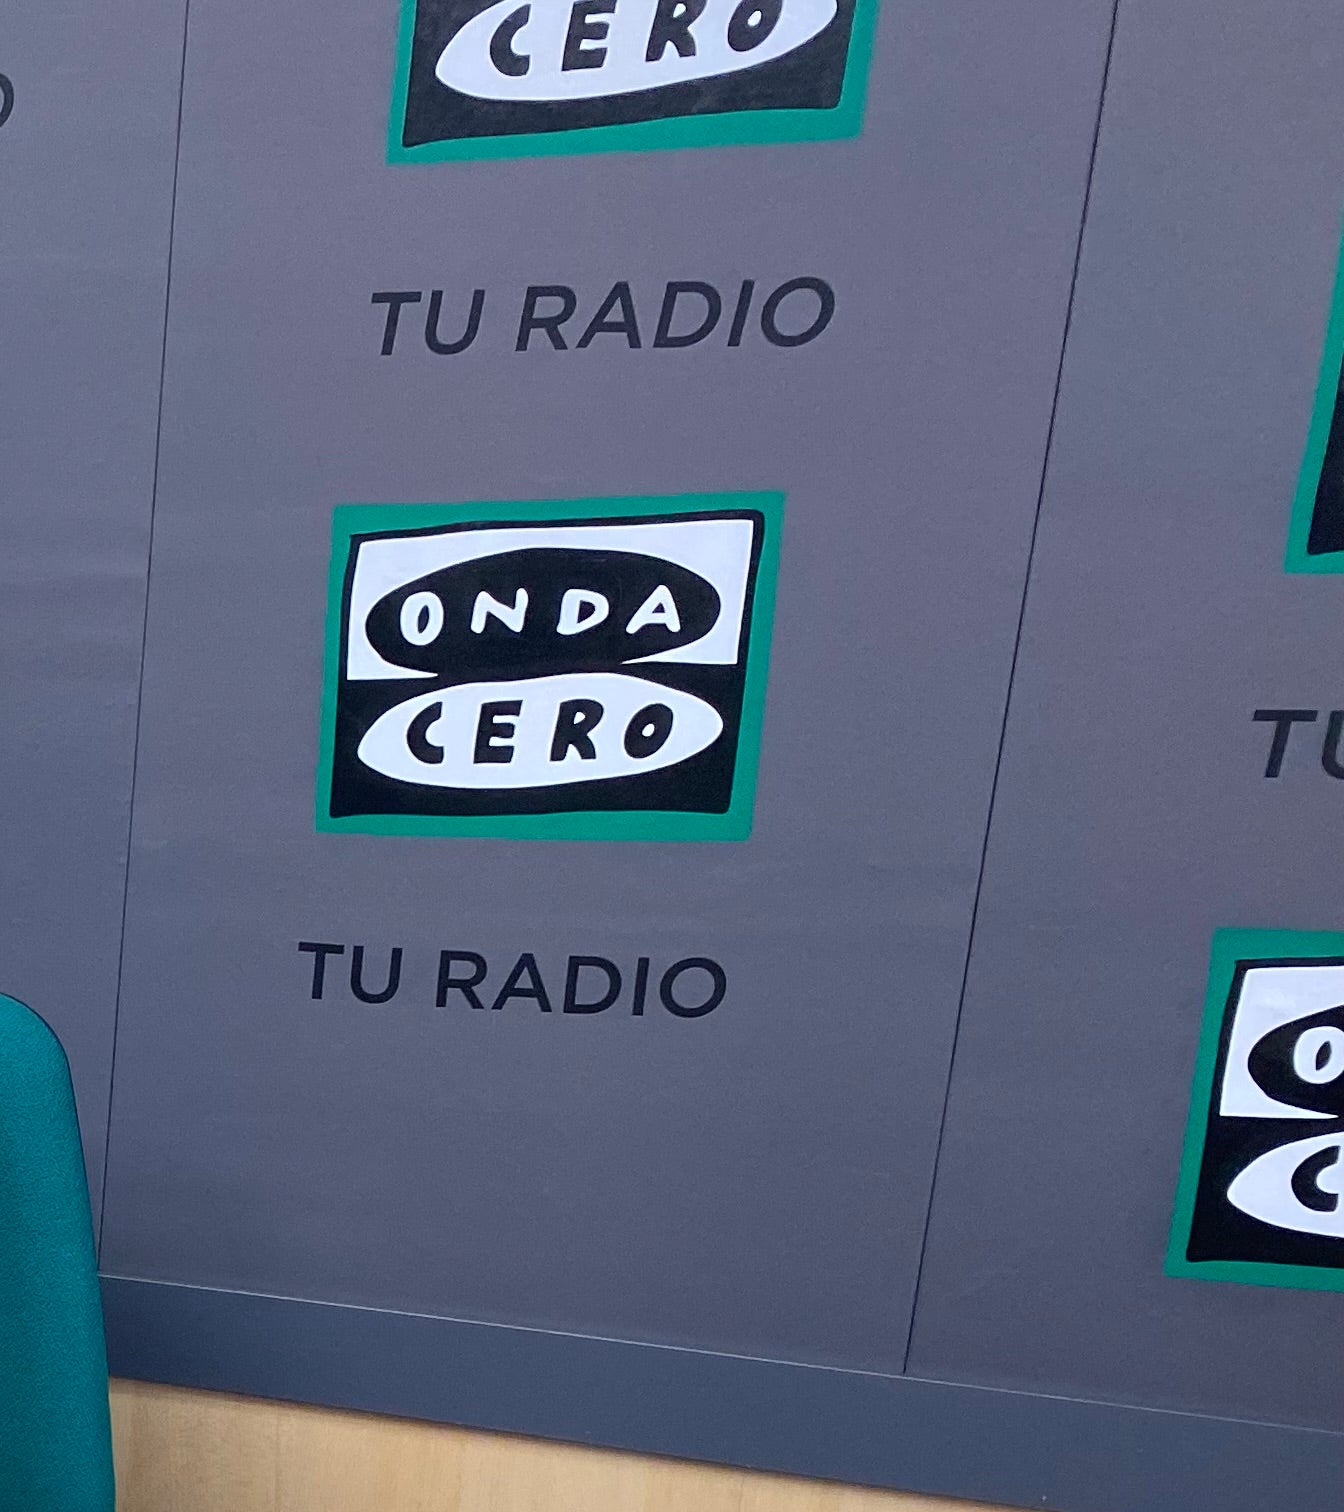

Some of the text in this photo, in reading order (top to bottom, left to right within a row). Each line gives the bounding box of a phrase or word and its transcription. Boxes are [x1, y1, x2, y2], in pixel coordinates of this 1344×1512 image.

[489, 0, 783, 77] CERO
[369, 276, 837, 357] TU RADIO
[399, 584, 681, 646] ONDA
[406, 698, 674, 764] CERO
[297, 941, 728, 1019] TU RADIO
